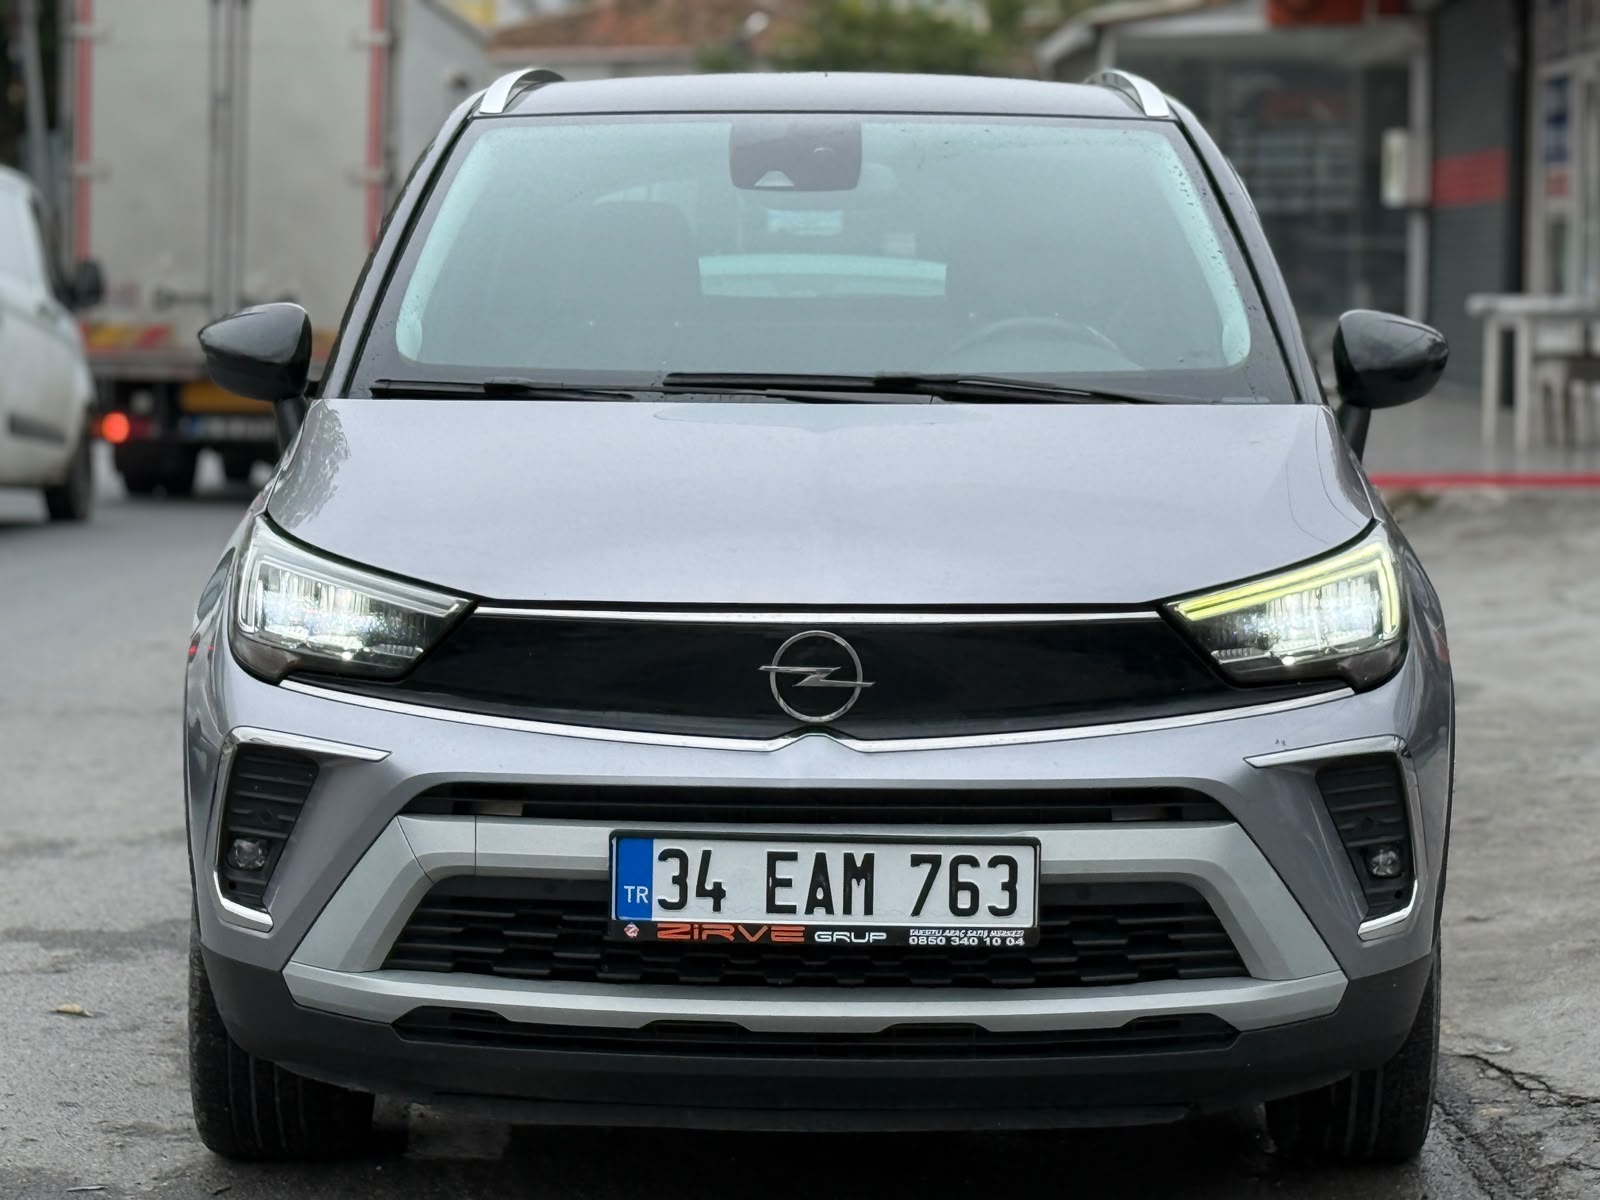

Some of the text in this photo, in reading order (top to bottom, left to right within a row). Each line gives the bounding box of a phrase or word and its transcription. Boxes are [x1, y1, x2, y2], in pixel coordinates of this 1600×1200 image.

[657, 848, 1019, 917] 34 EAM 763
[623, 885, 649, 904] TR
[814, 931, 887, 943] GRUP
[950, 937, 979, 946] 340
[983, 937, 1002, 947] 10
[1005, 937, 1026, 947] 04
